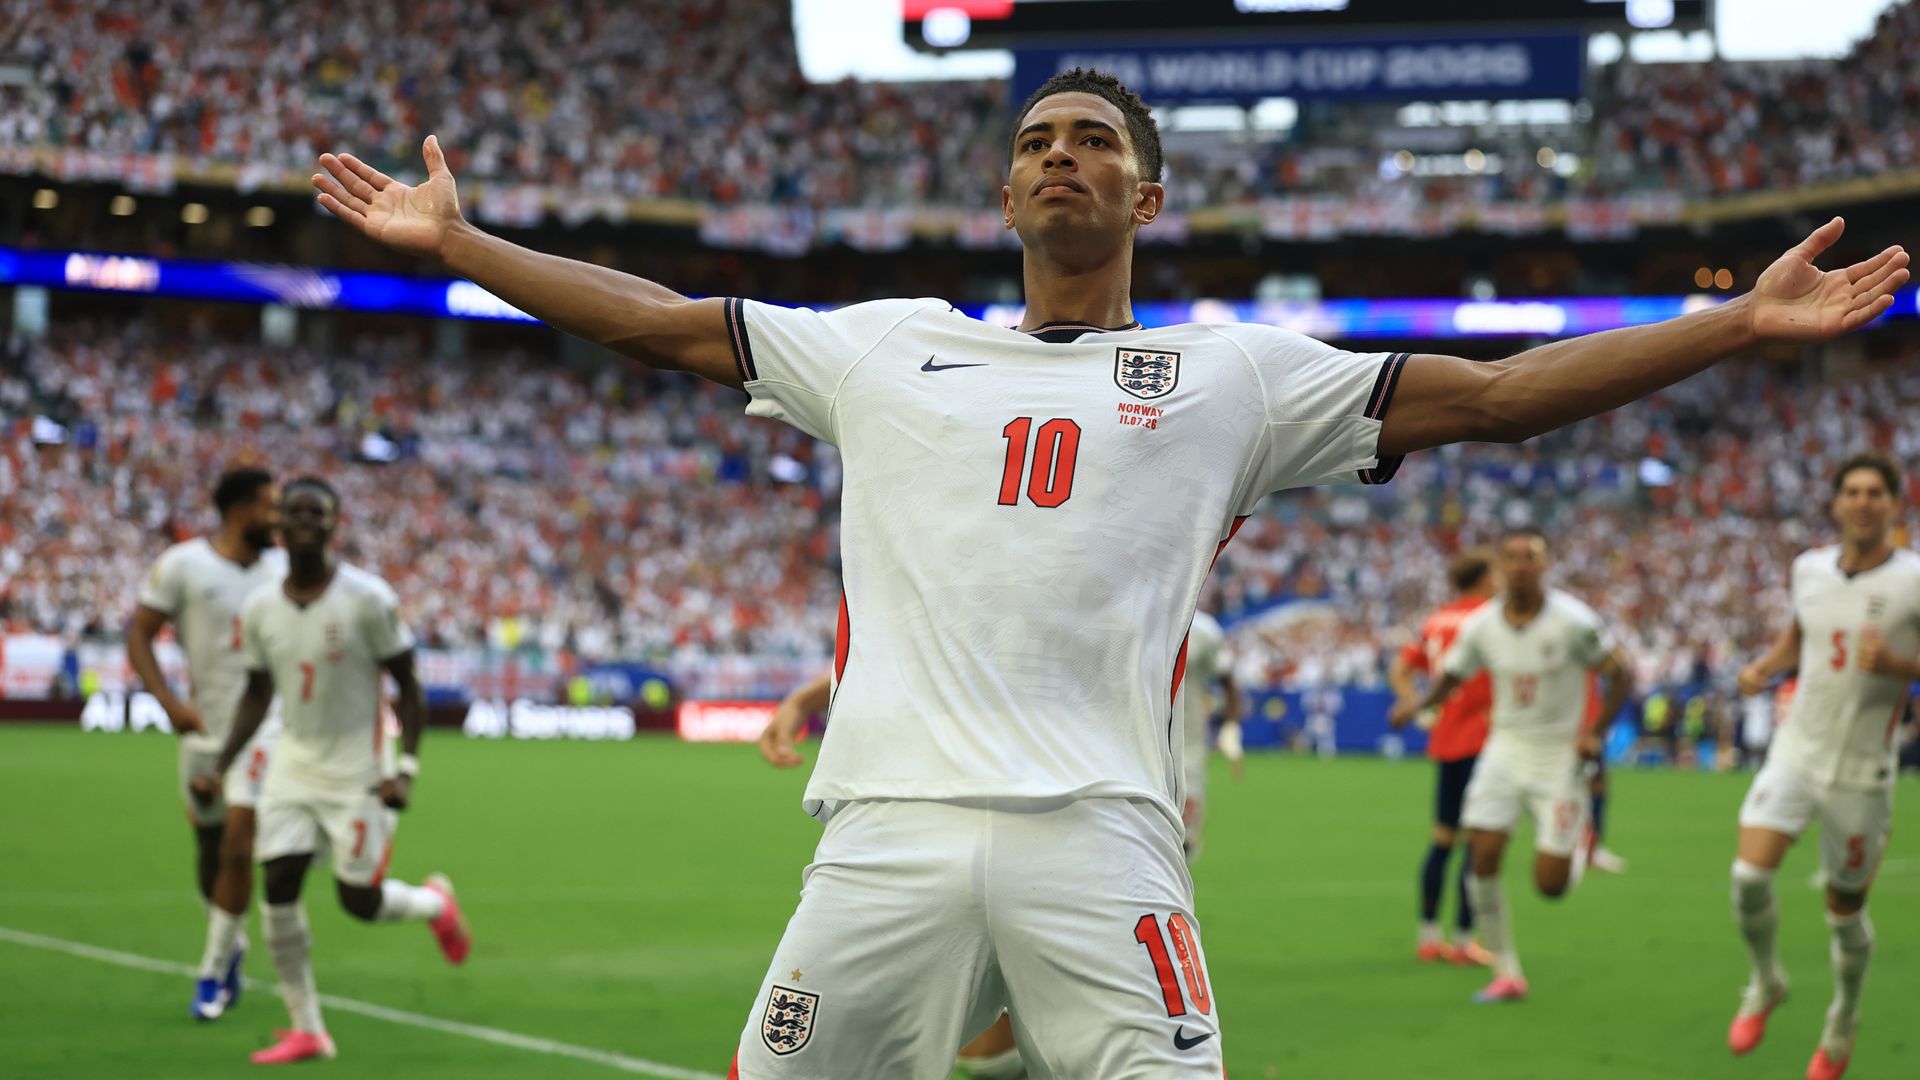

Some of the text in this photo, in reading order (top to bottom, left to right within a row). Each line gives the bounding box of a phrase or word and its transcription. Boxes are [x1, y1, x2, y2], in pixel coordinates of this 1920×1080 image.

[1148, 50, 1294, 93] WORLD
[1298, 48, 1377, 91] CUP
[1117, 402, 1164, 417] NORWAY
[1119, 414, 1157, 430] 11.07.26
[997, 417, 1082, 508] 10
[298, 661, 317, 703] 7
[351, 818, 369, 860] 7
[1134, 913, 1211, 1017] 10
